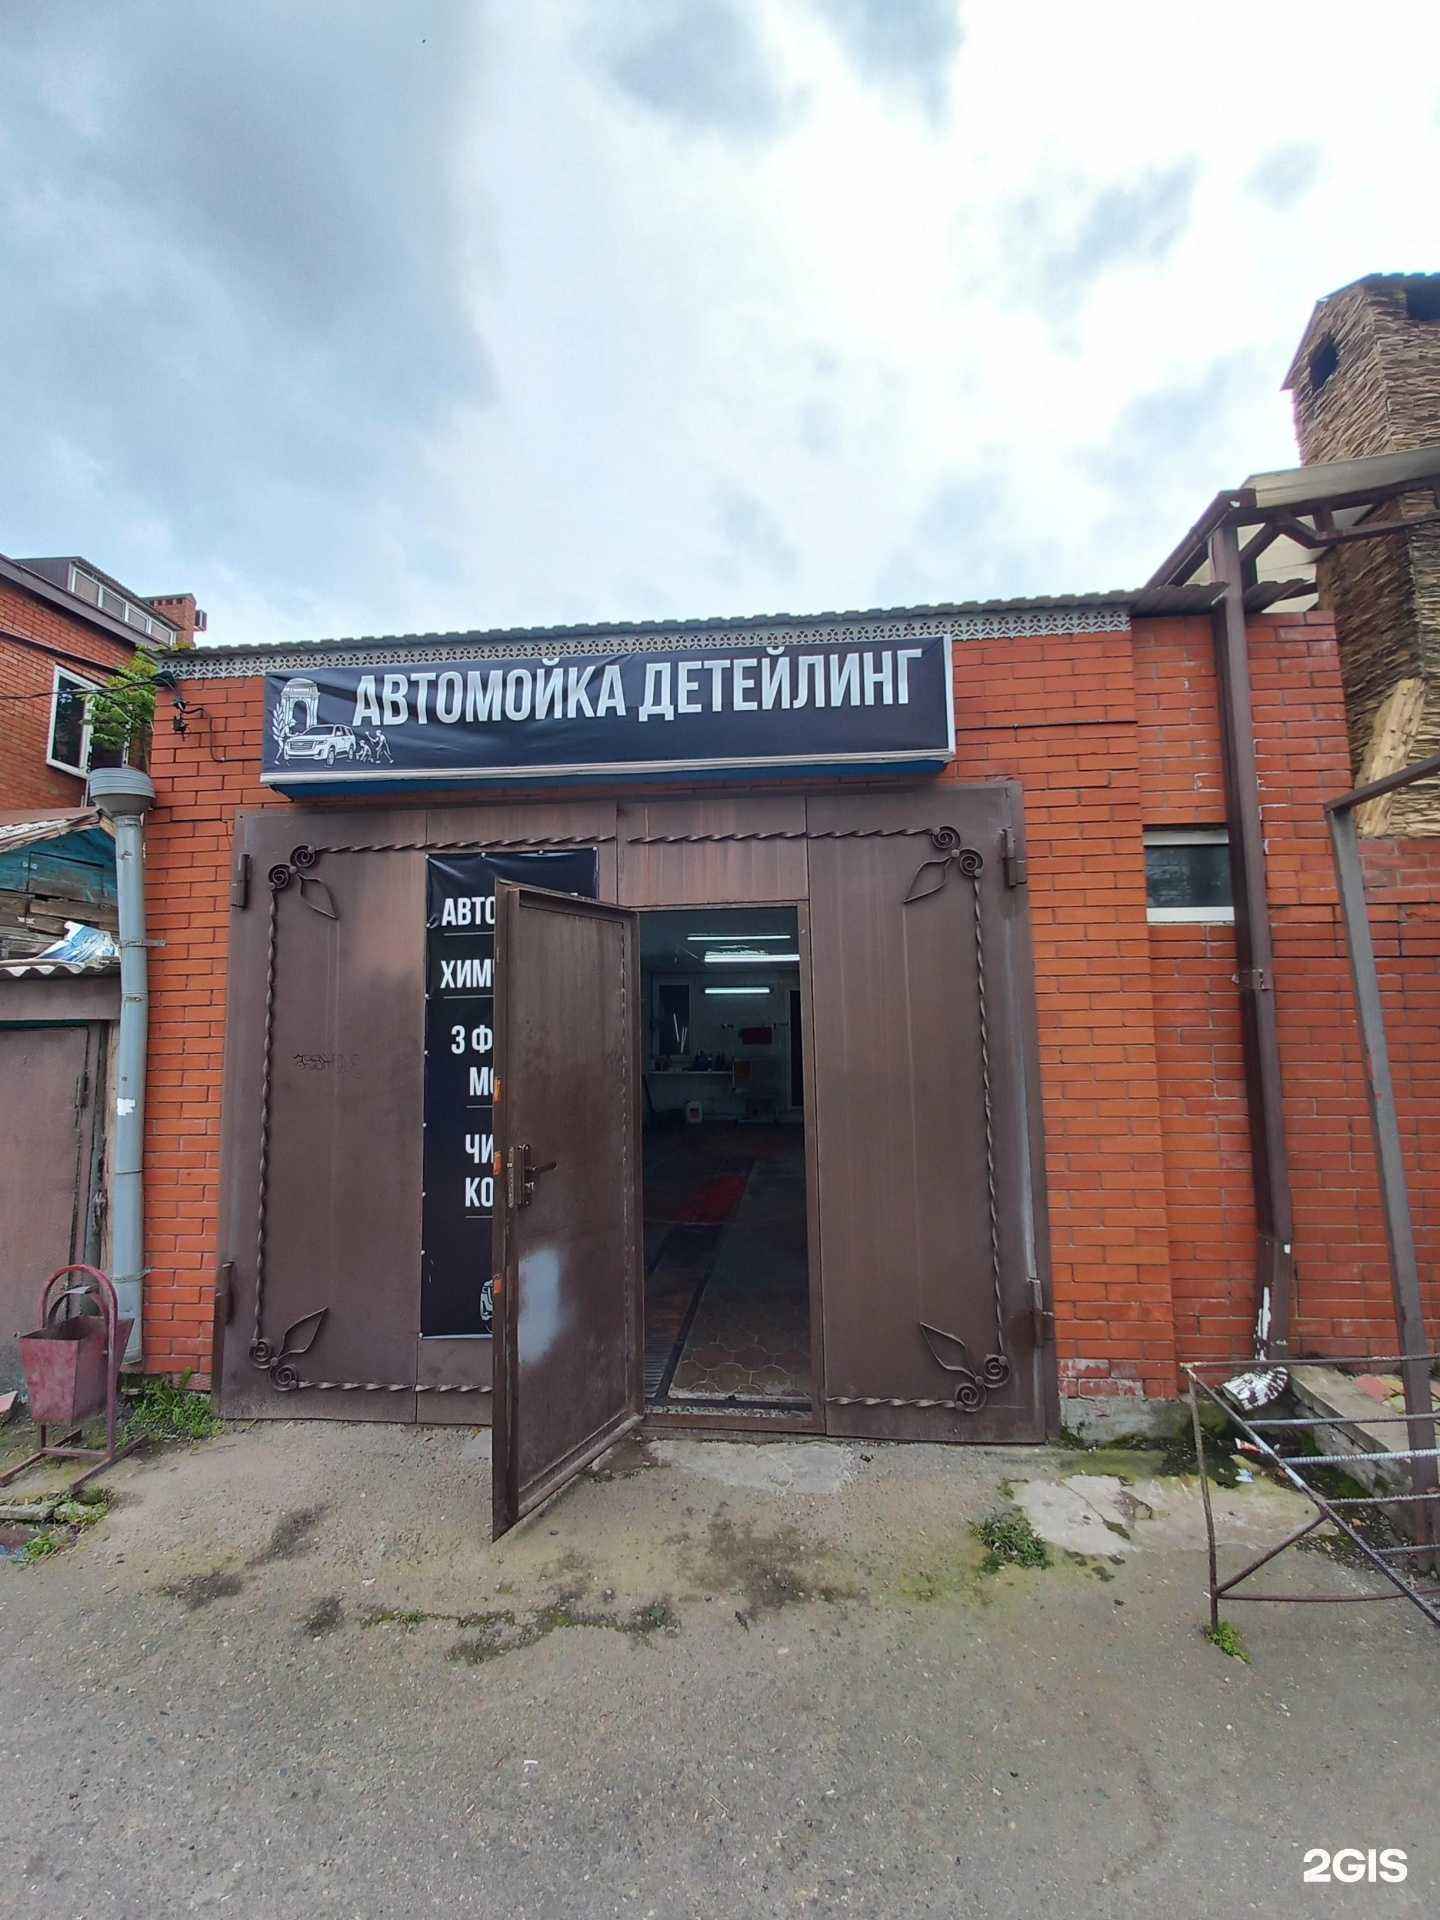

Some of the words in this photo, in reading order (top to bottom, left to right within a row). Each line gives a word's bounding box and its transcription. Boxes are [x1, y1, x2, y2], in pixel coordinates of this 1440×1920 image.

[352, 657, 626, 726] АВТОМОЙКА
[638, 646, 922, 722] ДЕТЕЙЛИНГ
[441, 896, 496, 926] АВТО
[440, 959, 495, 988] ХИМ
[469, 1066, 494, 1096] М
[465, 1177, 493, 1207] КО
